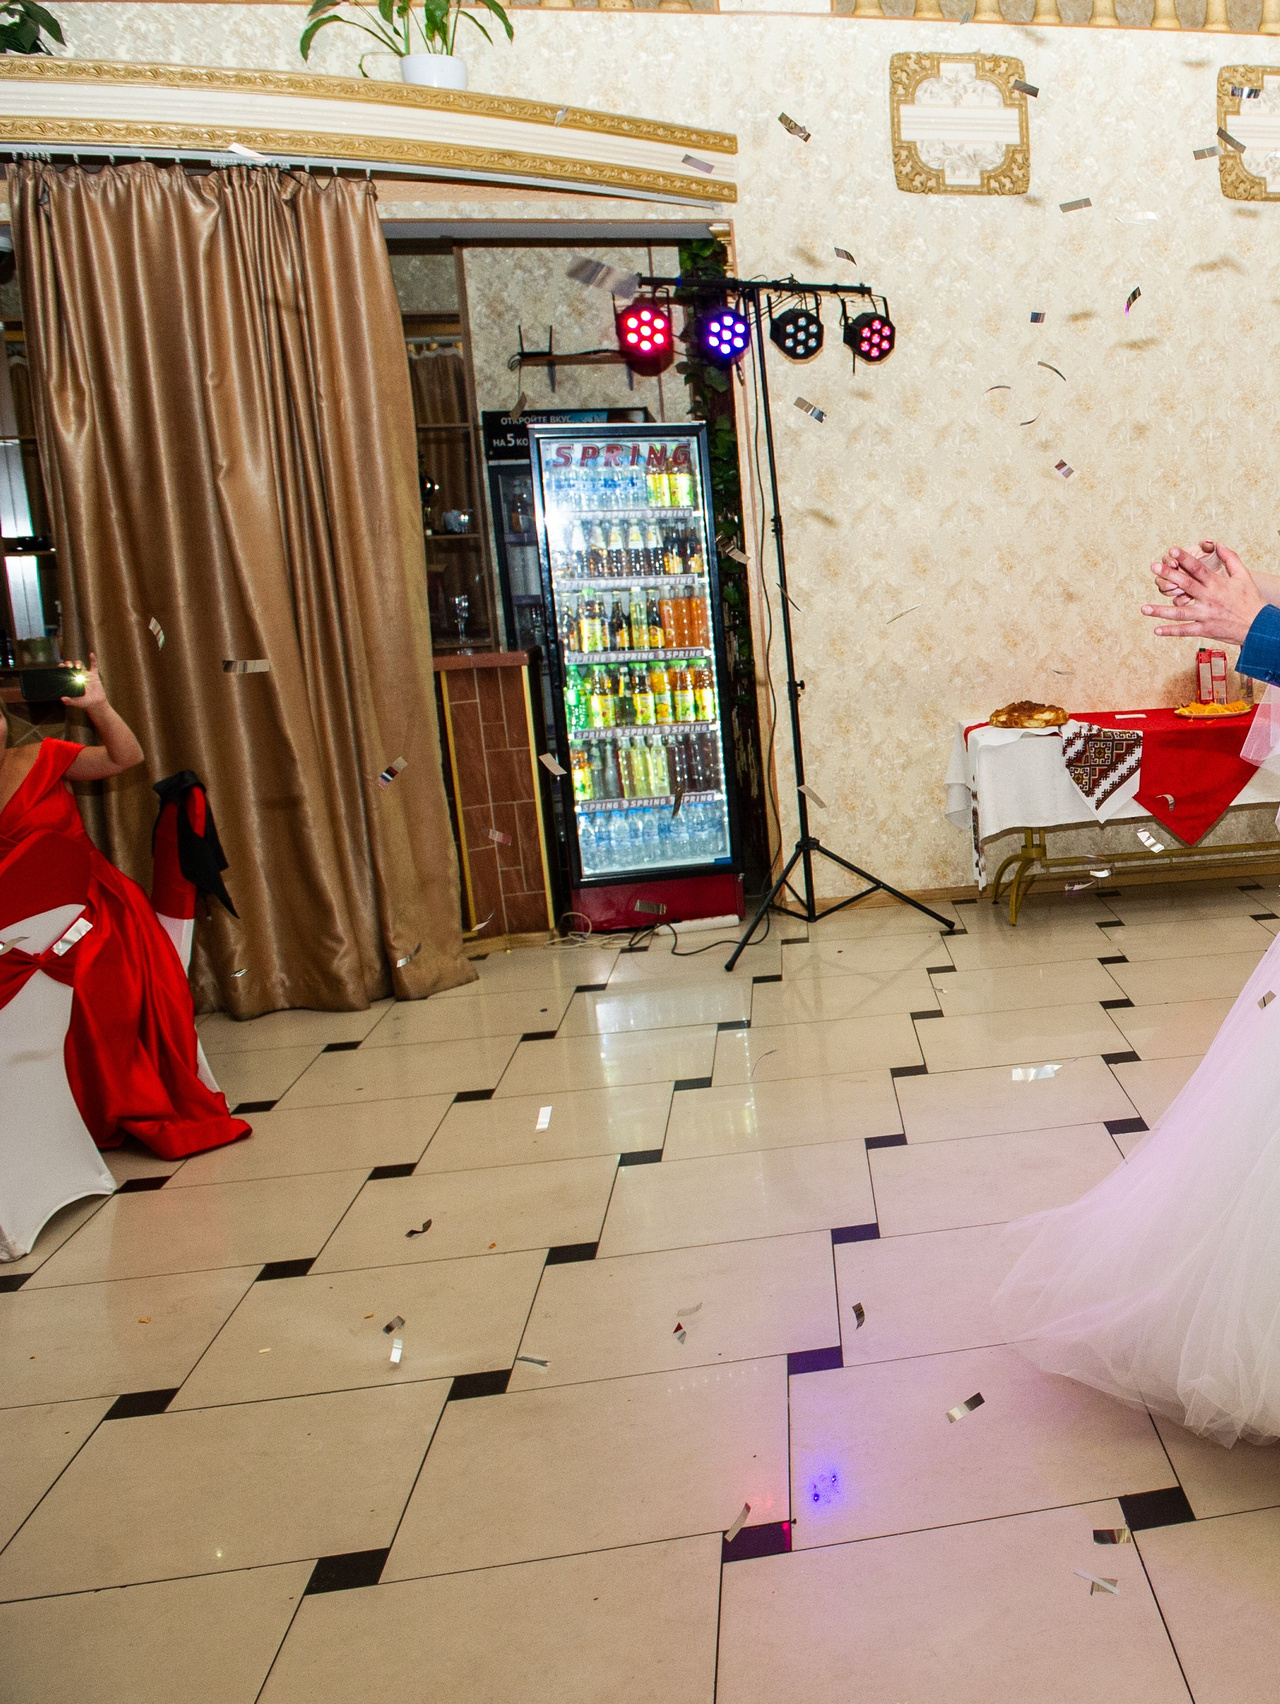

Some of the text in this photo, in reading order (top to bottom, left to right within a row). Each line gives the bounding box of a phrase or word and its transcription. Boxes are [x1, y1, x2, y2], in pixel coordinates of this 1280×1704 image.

[493, 439, 506, 447] НА
[507, 433, 515, 447] 5
[552, 443, 691, 468] SPRING
[654, 509, 691, 519] SPRING
[607, 579, 645, 588] SPRING
[656, 576, 694, 586] SPRING
[617, 652, 655, 662] SPRING
[666, 649, 702, 659] SPRING
[575, 724, 708, 739] SPRING SPRING SPRING
[582, 793, 714, 812] SPRING SPRING PRING
